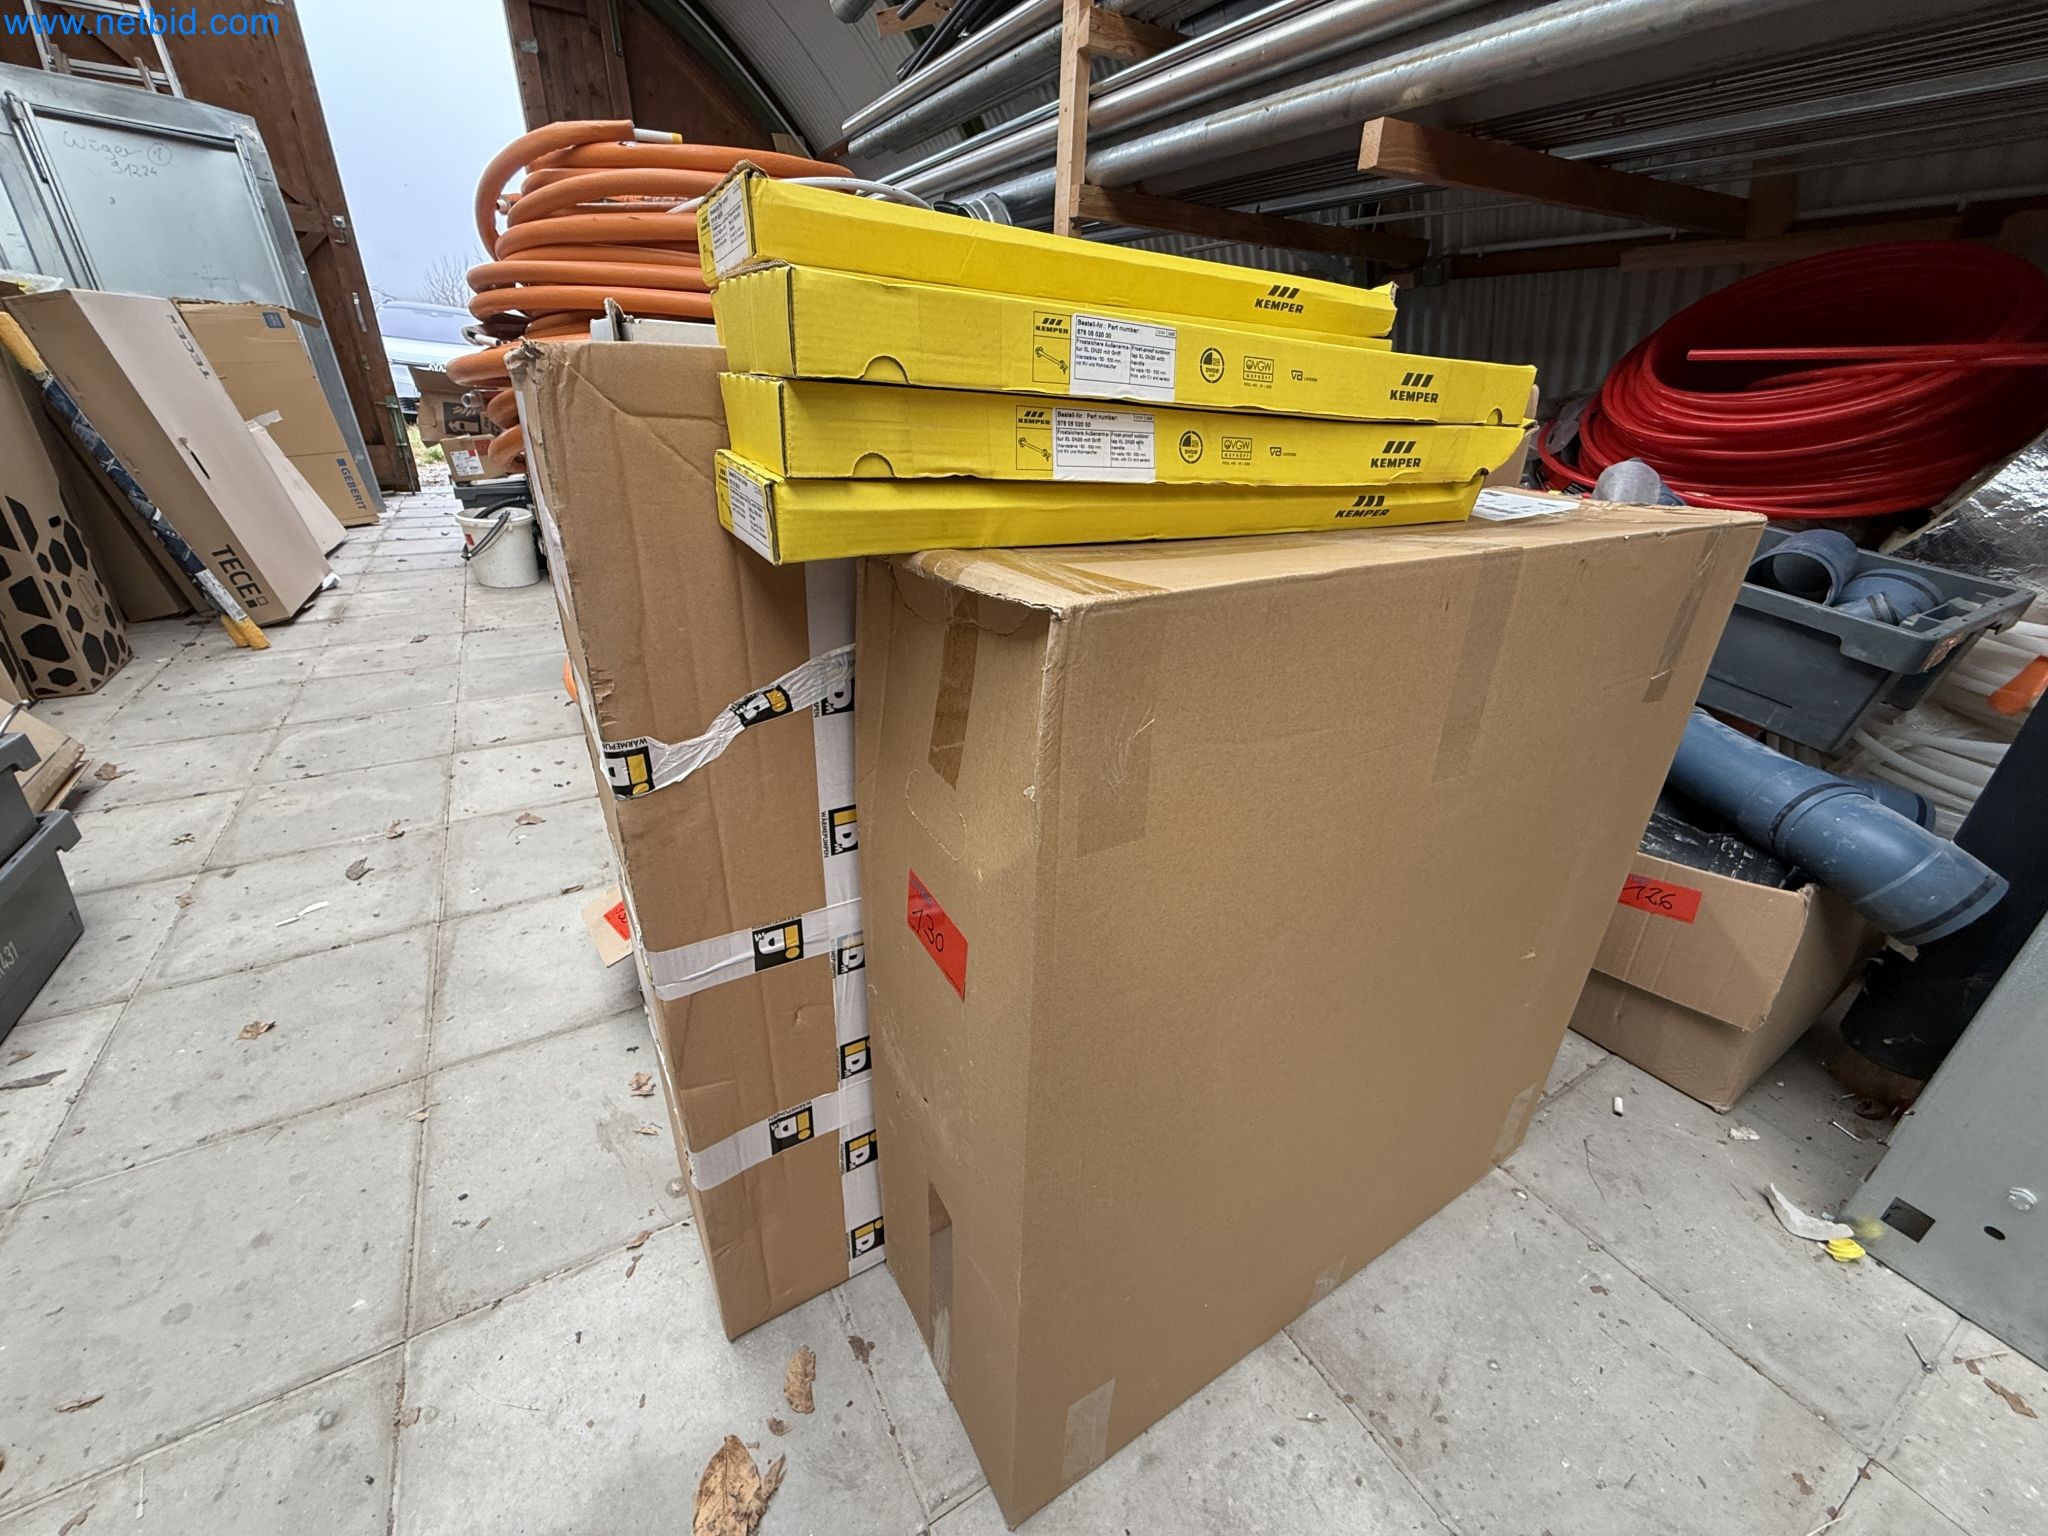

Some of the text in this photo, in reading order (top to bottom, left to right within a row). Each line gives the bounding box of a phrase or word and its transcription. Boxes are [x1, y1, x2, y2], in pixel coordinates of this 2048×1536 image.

[1254, 298, 1304, 314] KEMPER
[1035, 325, 1069, 335] KEMPER
[1107, 323, 1118, 331] Part
[1389, 389, 1439, 403] KEMPER
[1370, 457, 1421, 469] KEMPER
[340, 467, 367, 510] GEBERIT
[1334, 508, 1390, 518] KEMPER
[211, 544, 262, 599] TECE
[912, 909, 944, 952] 730
